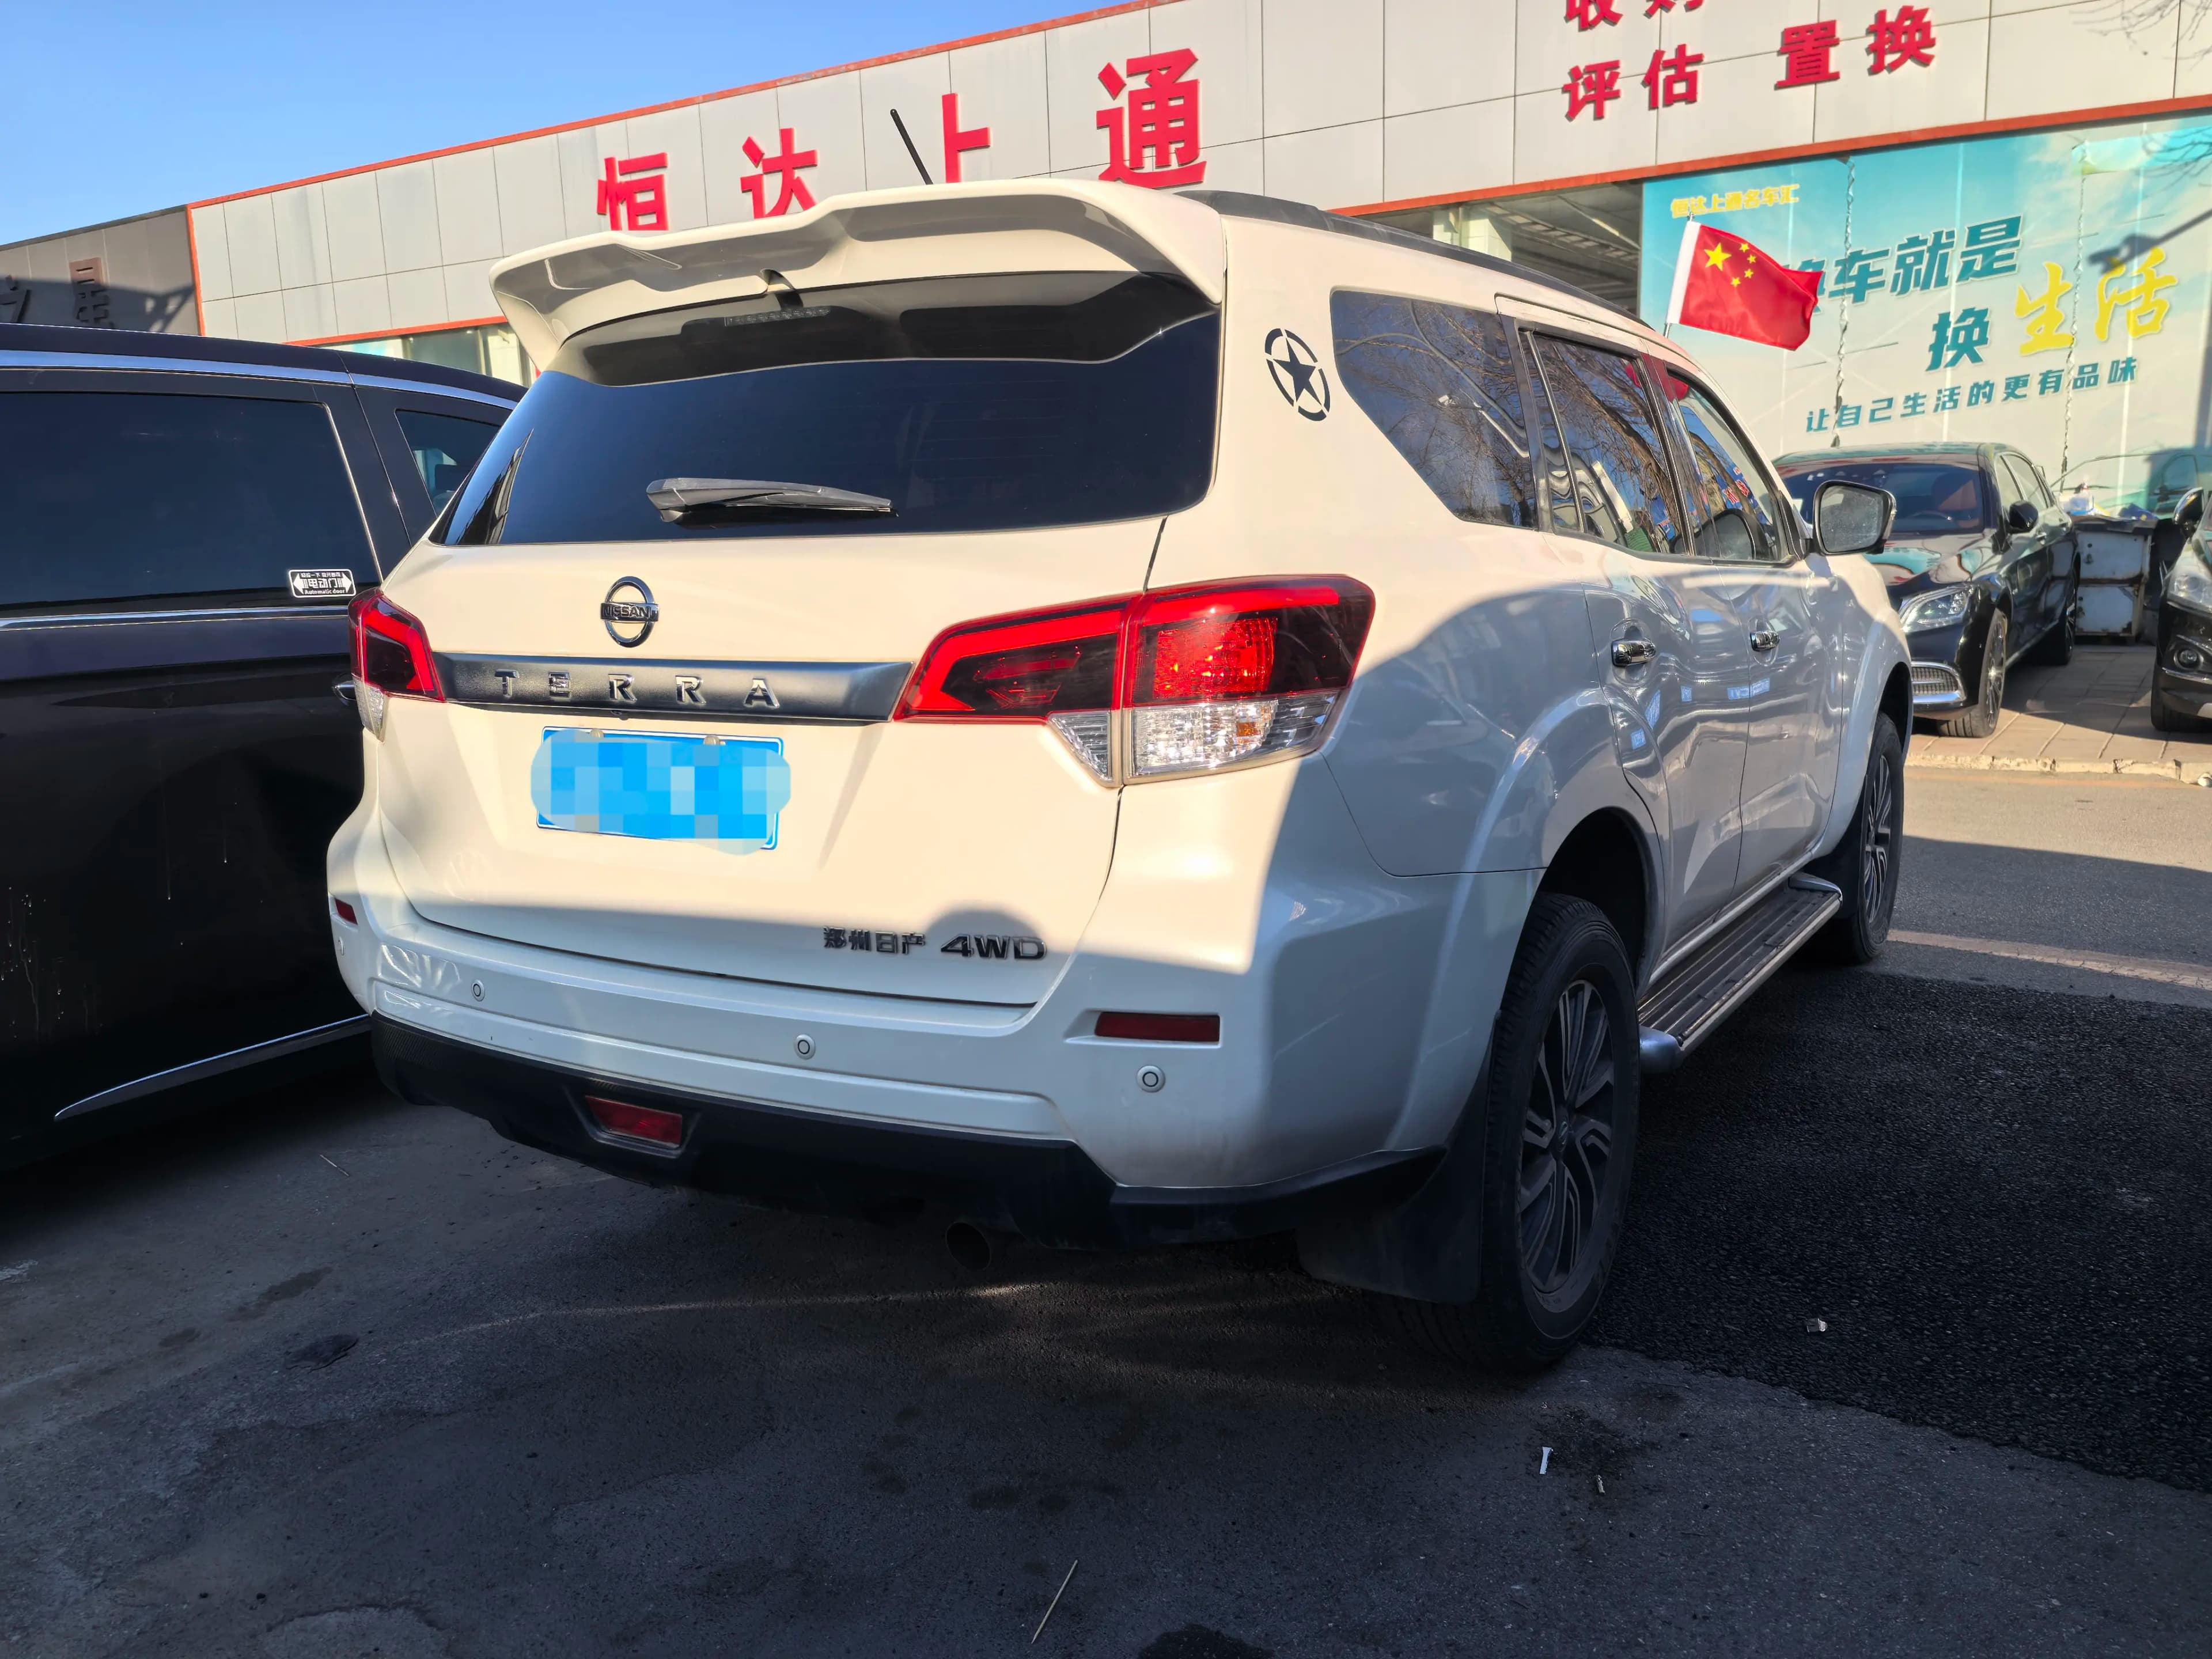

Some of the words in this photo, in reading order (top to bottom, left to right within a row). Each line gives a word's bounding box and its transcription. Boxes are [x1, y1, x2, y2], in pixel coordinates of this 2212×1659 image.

[1562, 44, 1705, 122] 评估
[1774, 6, 1936, 90] 置换
[597, 48, 1207, 232] 恒达上通
[1671, 184, 1800, 218] 恒达上通名车汇
[1925, 307, 1991, 372] 换
[2015, 247, 2179, 356] 生活
[1806, 356, 2138, 433] 让自己生活的更有品味
[603, 605, 651, 618] NISSAN
[494, 668, 780, 709] TERRA
[823, 926, 926, 955] 郑州日产
[940, 933, 1047, 960] 4WD
